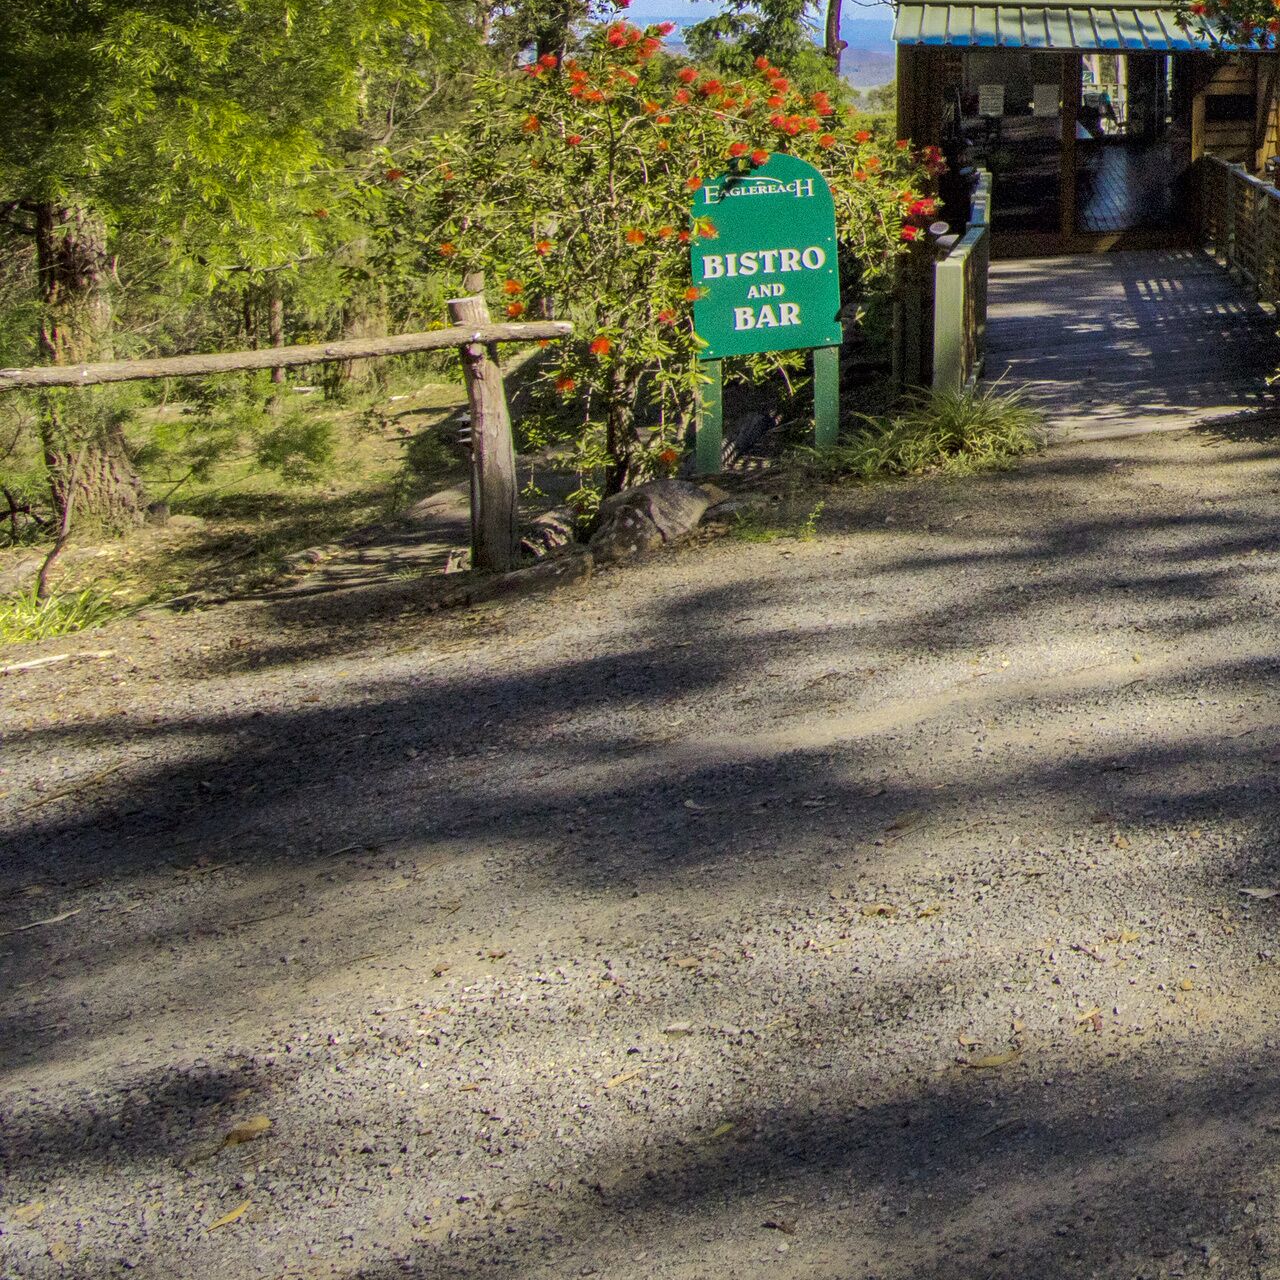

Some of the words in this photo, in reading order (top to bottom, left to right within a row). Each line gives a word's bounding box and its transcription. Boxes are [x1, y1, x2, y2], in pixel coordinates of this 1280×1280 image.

[702, 246, 826, 279] BISTRO
[747, 283, 785, 299] AND
[734, 302, 801, 331] BAR
